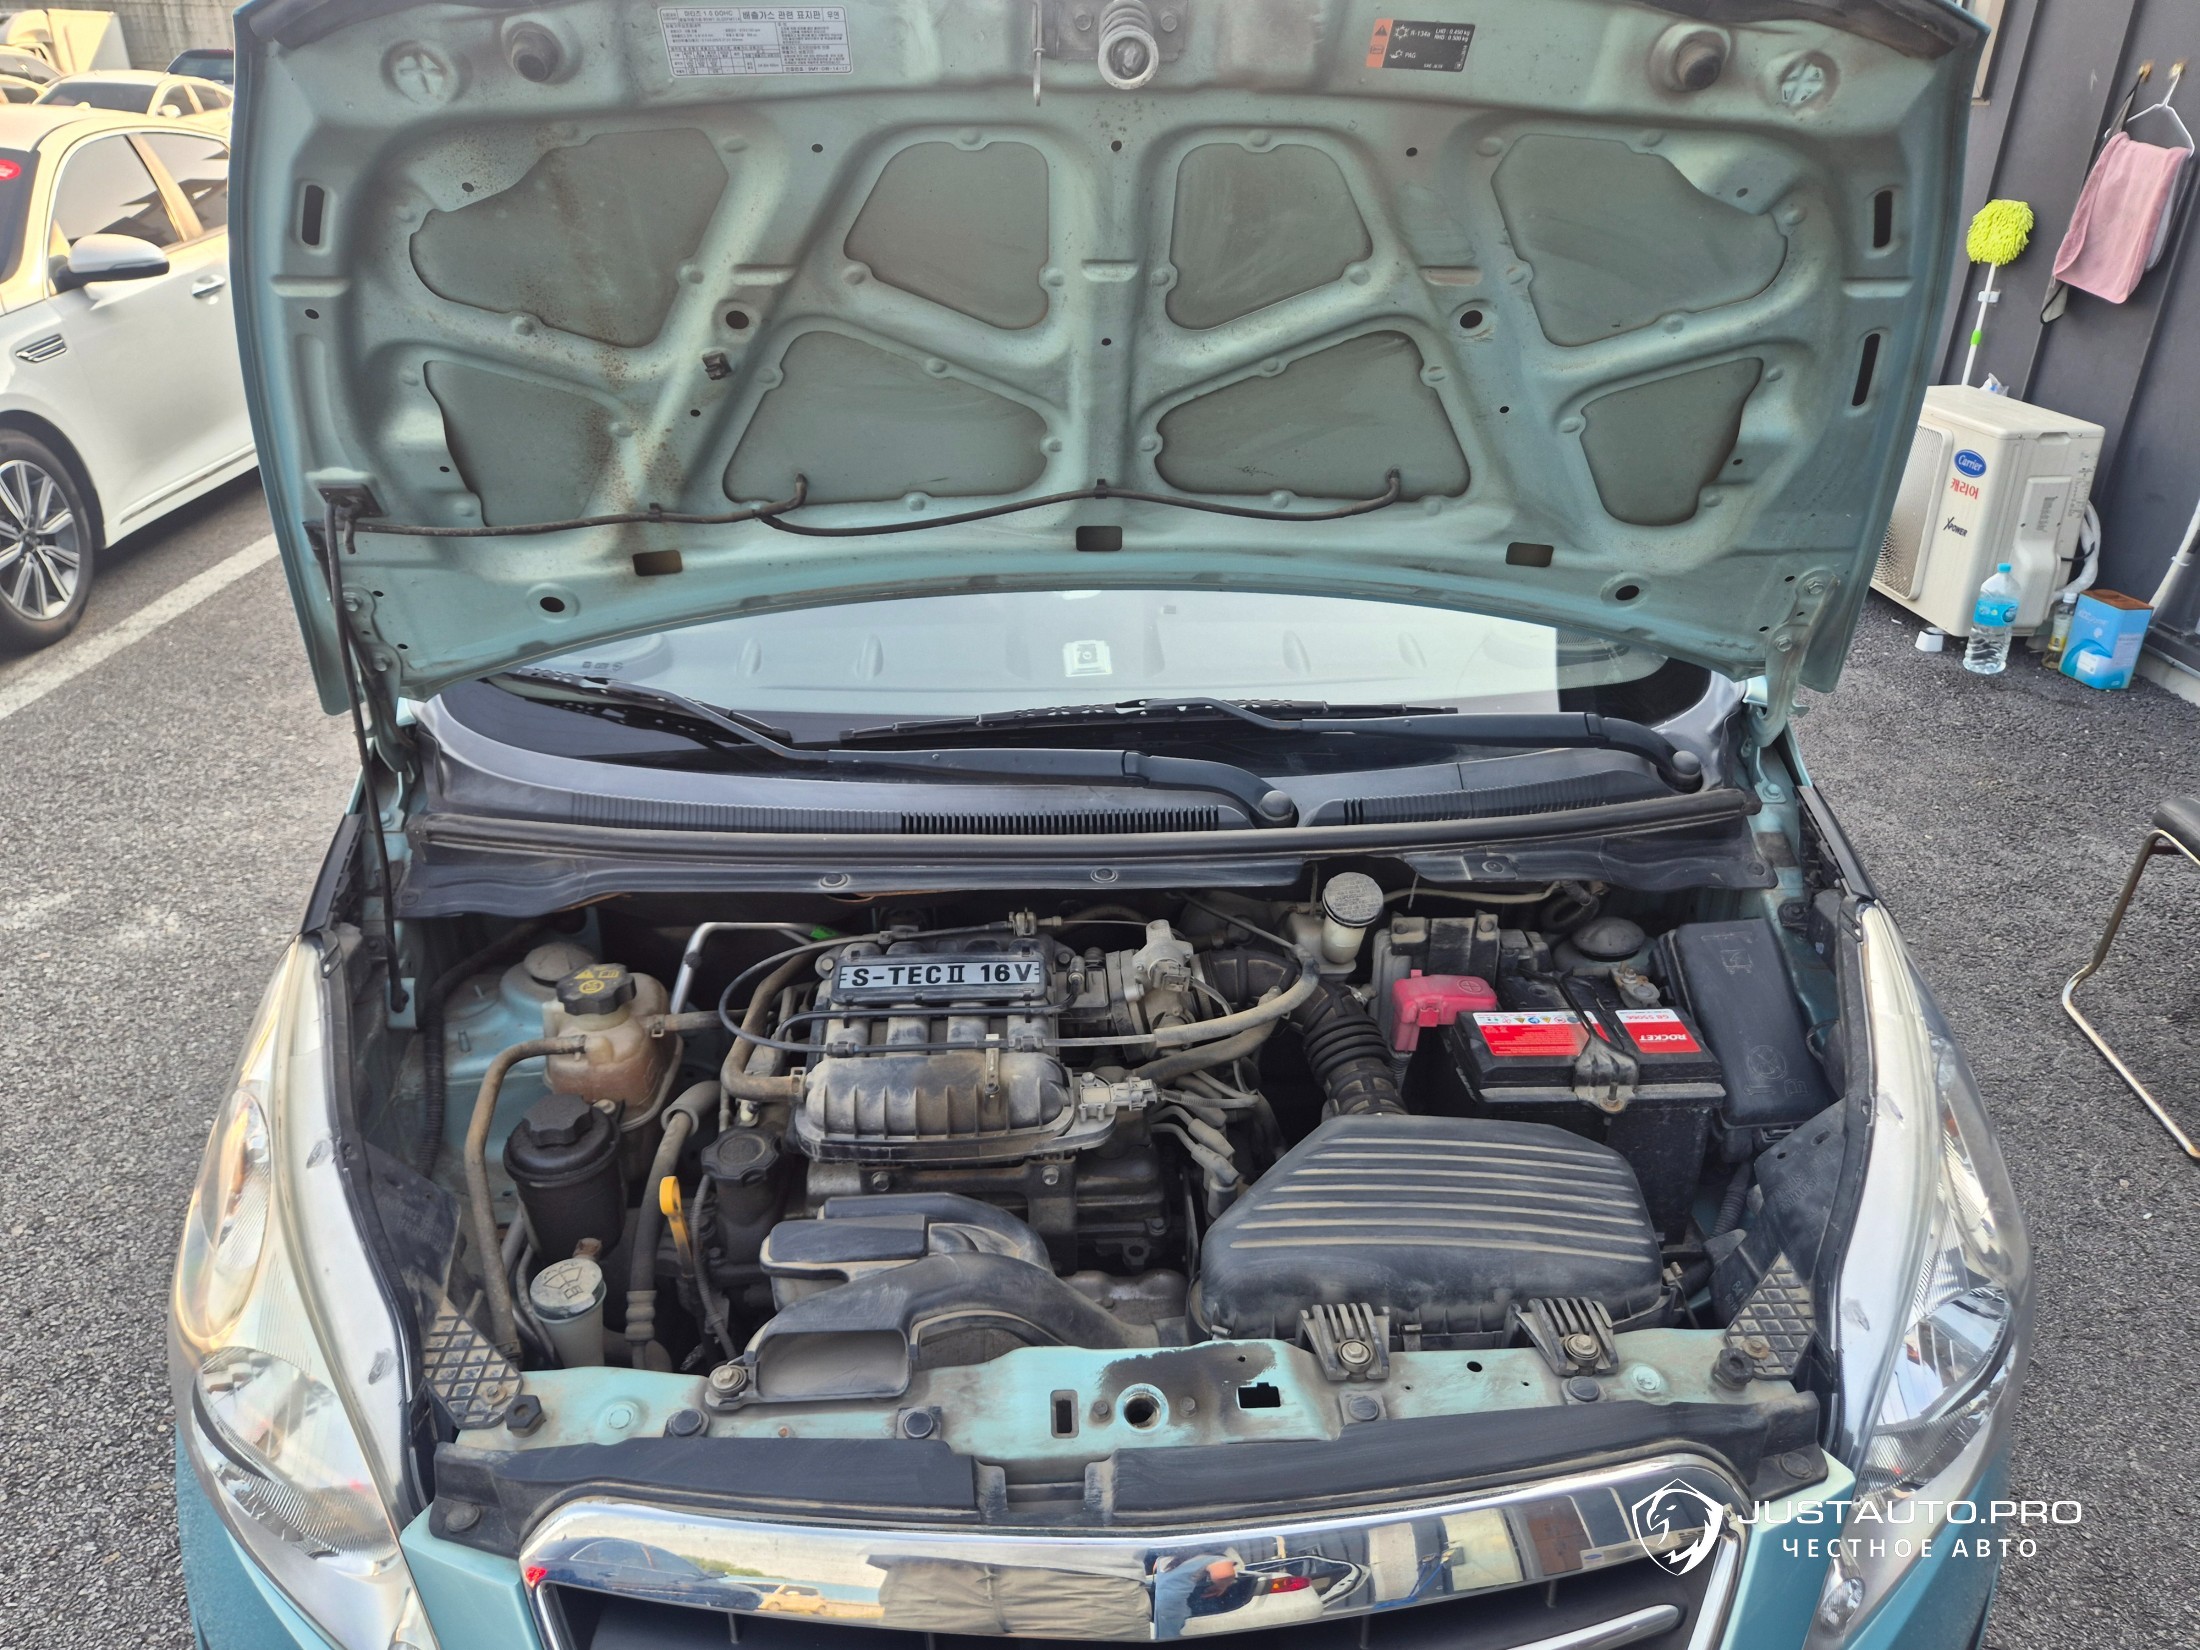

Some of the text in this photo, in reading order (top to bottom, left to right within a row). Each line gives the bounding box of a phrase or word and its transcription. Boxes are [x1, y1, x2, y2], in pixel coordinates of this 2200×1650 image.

[742, 11, 775, 20] 배출가스
[778, 11, 794, 20] 관련
[797, 10, 821, 20] 표지판
[1958, 454, 1983, 472] Carrier
[1950, 477, 1980, 500] 캐리어
[980, 963, 1033, 983] 16V
